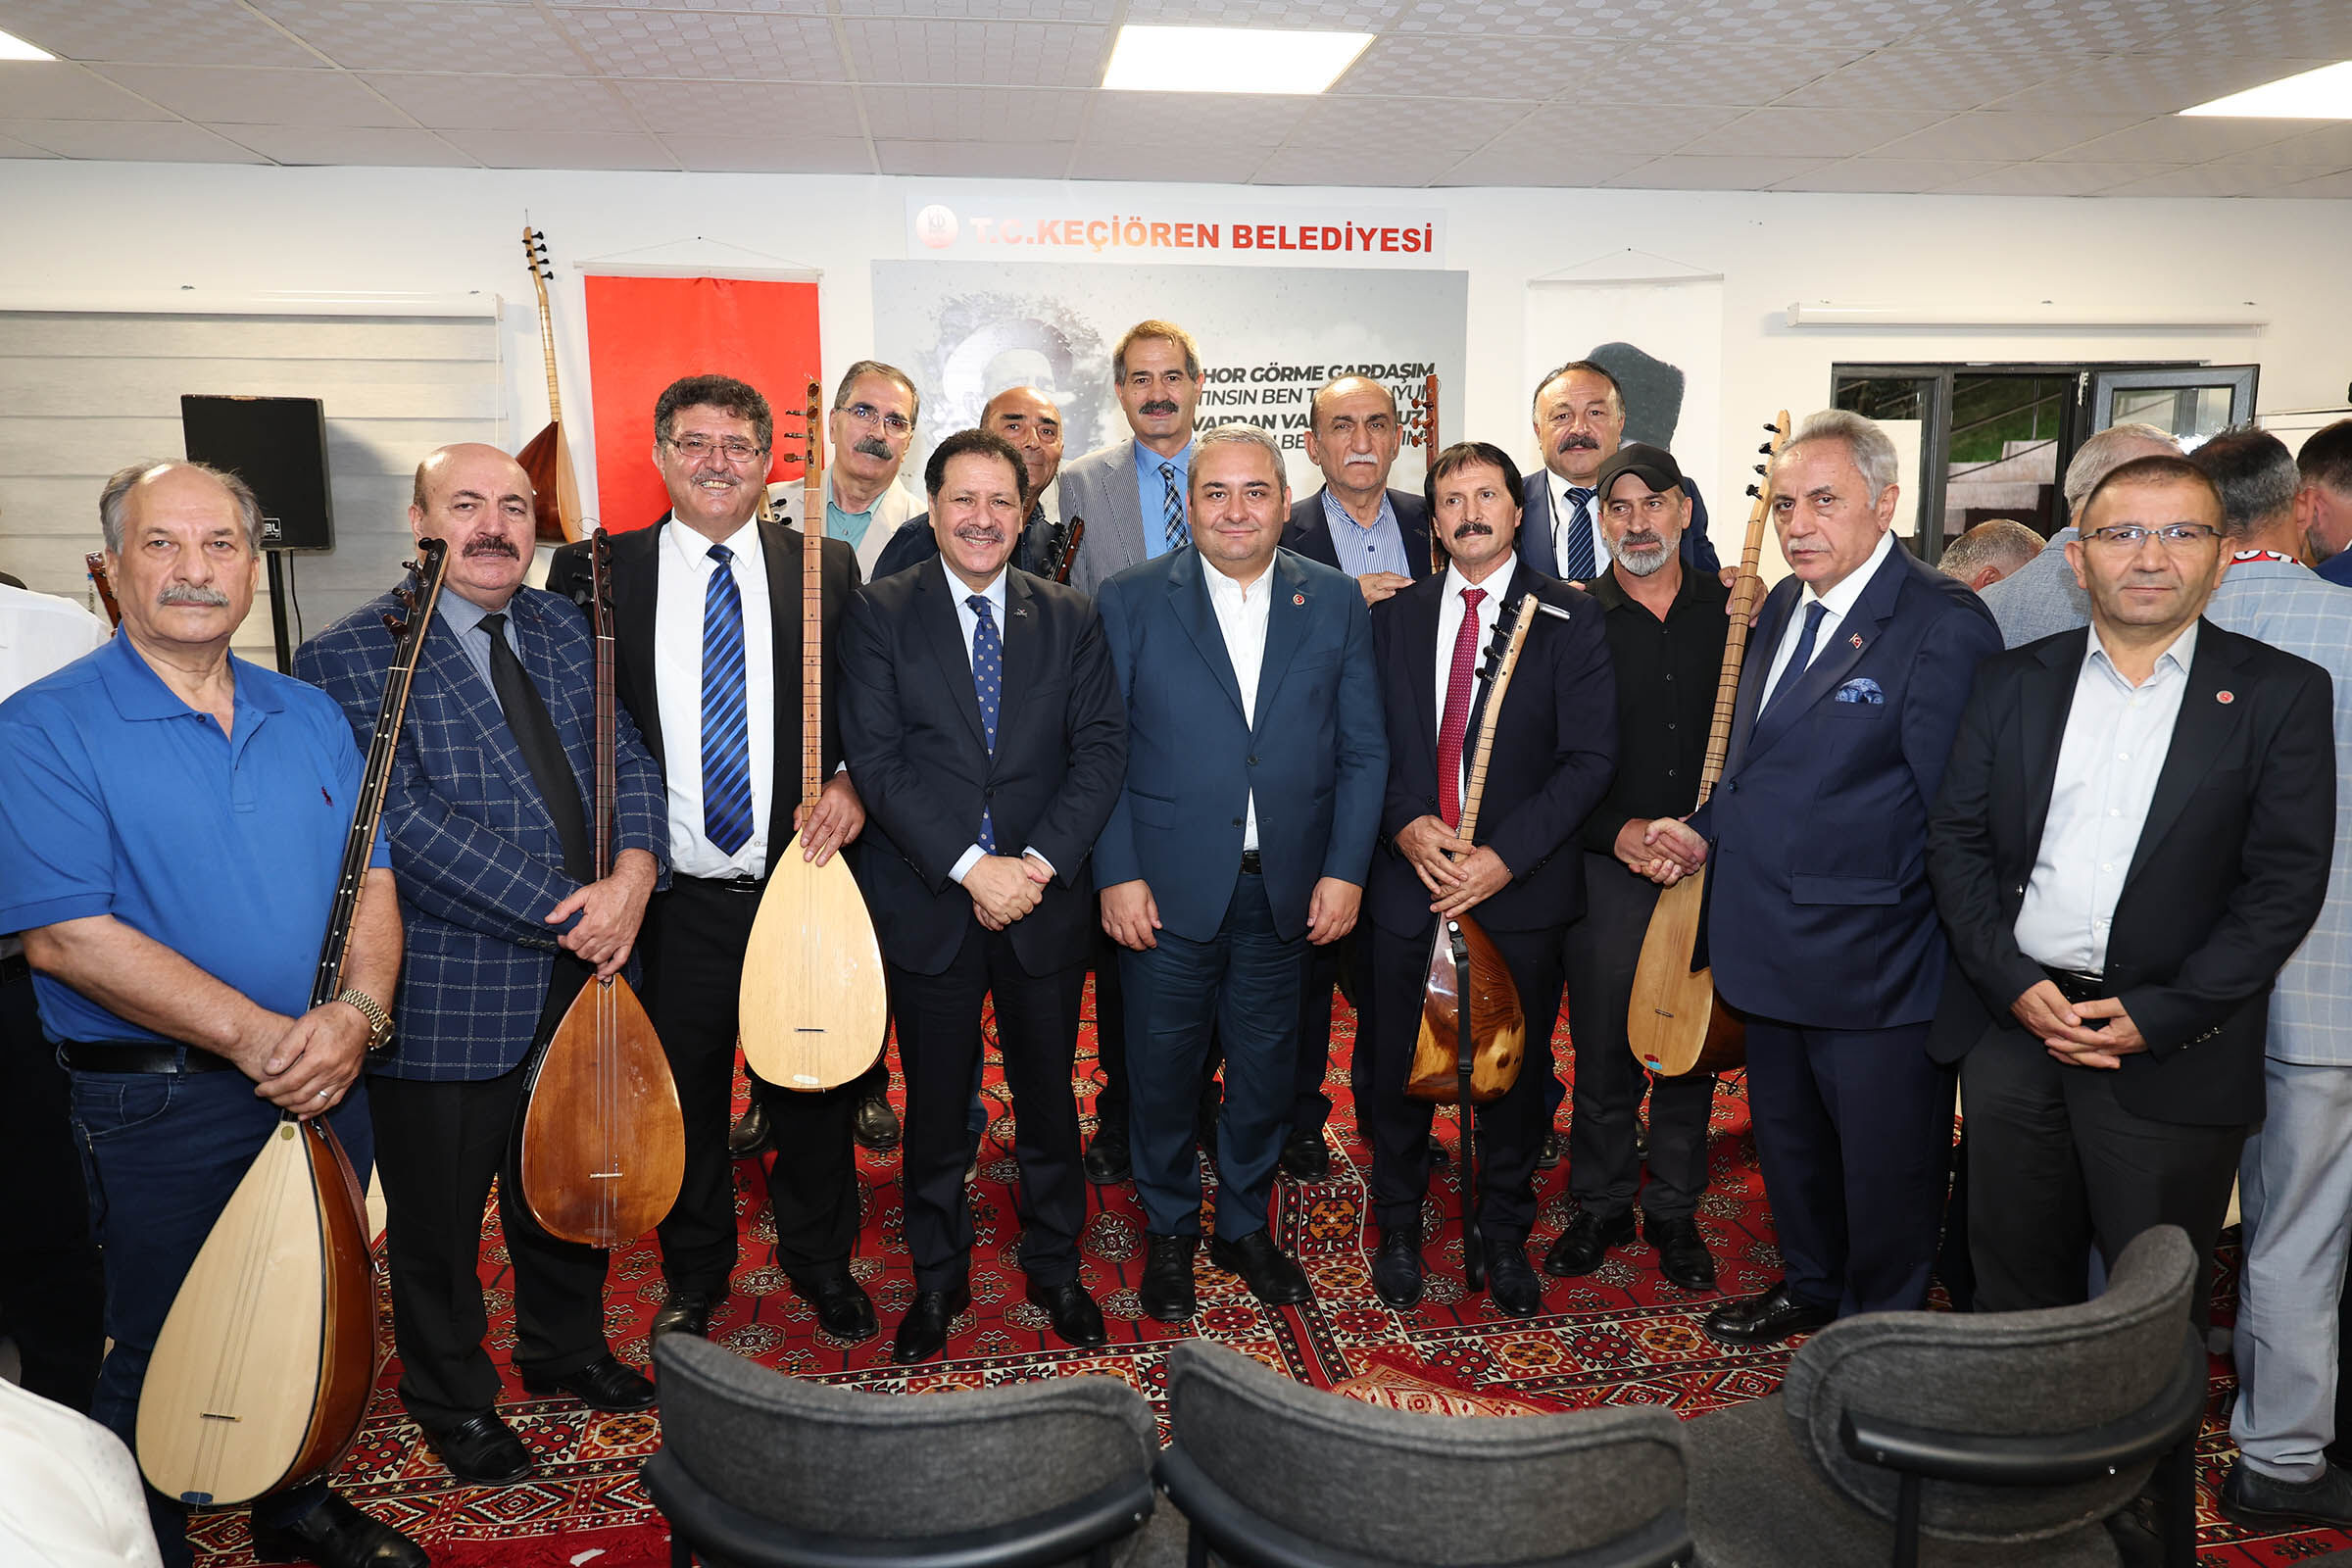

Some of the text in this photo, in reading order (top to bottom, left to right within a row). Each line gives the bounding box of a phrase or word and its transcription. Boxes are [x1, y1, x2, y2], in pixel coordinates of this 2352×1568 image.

[1232, 220, 1433, 253] BELEDİYESİ
[1250, 362, 1325, 383] GÖRME
[1261, 388, 1302, 404] BEN
[1281, 414, 1309, 429] VA
